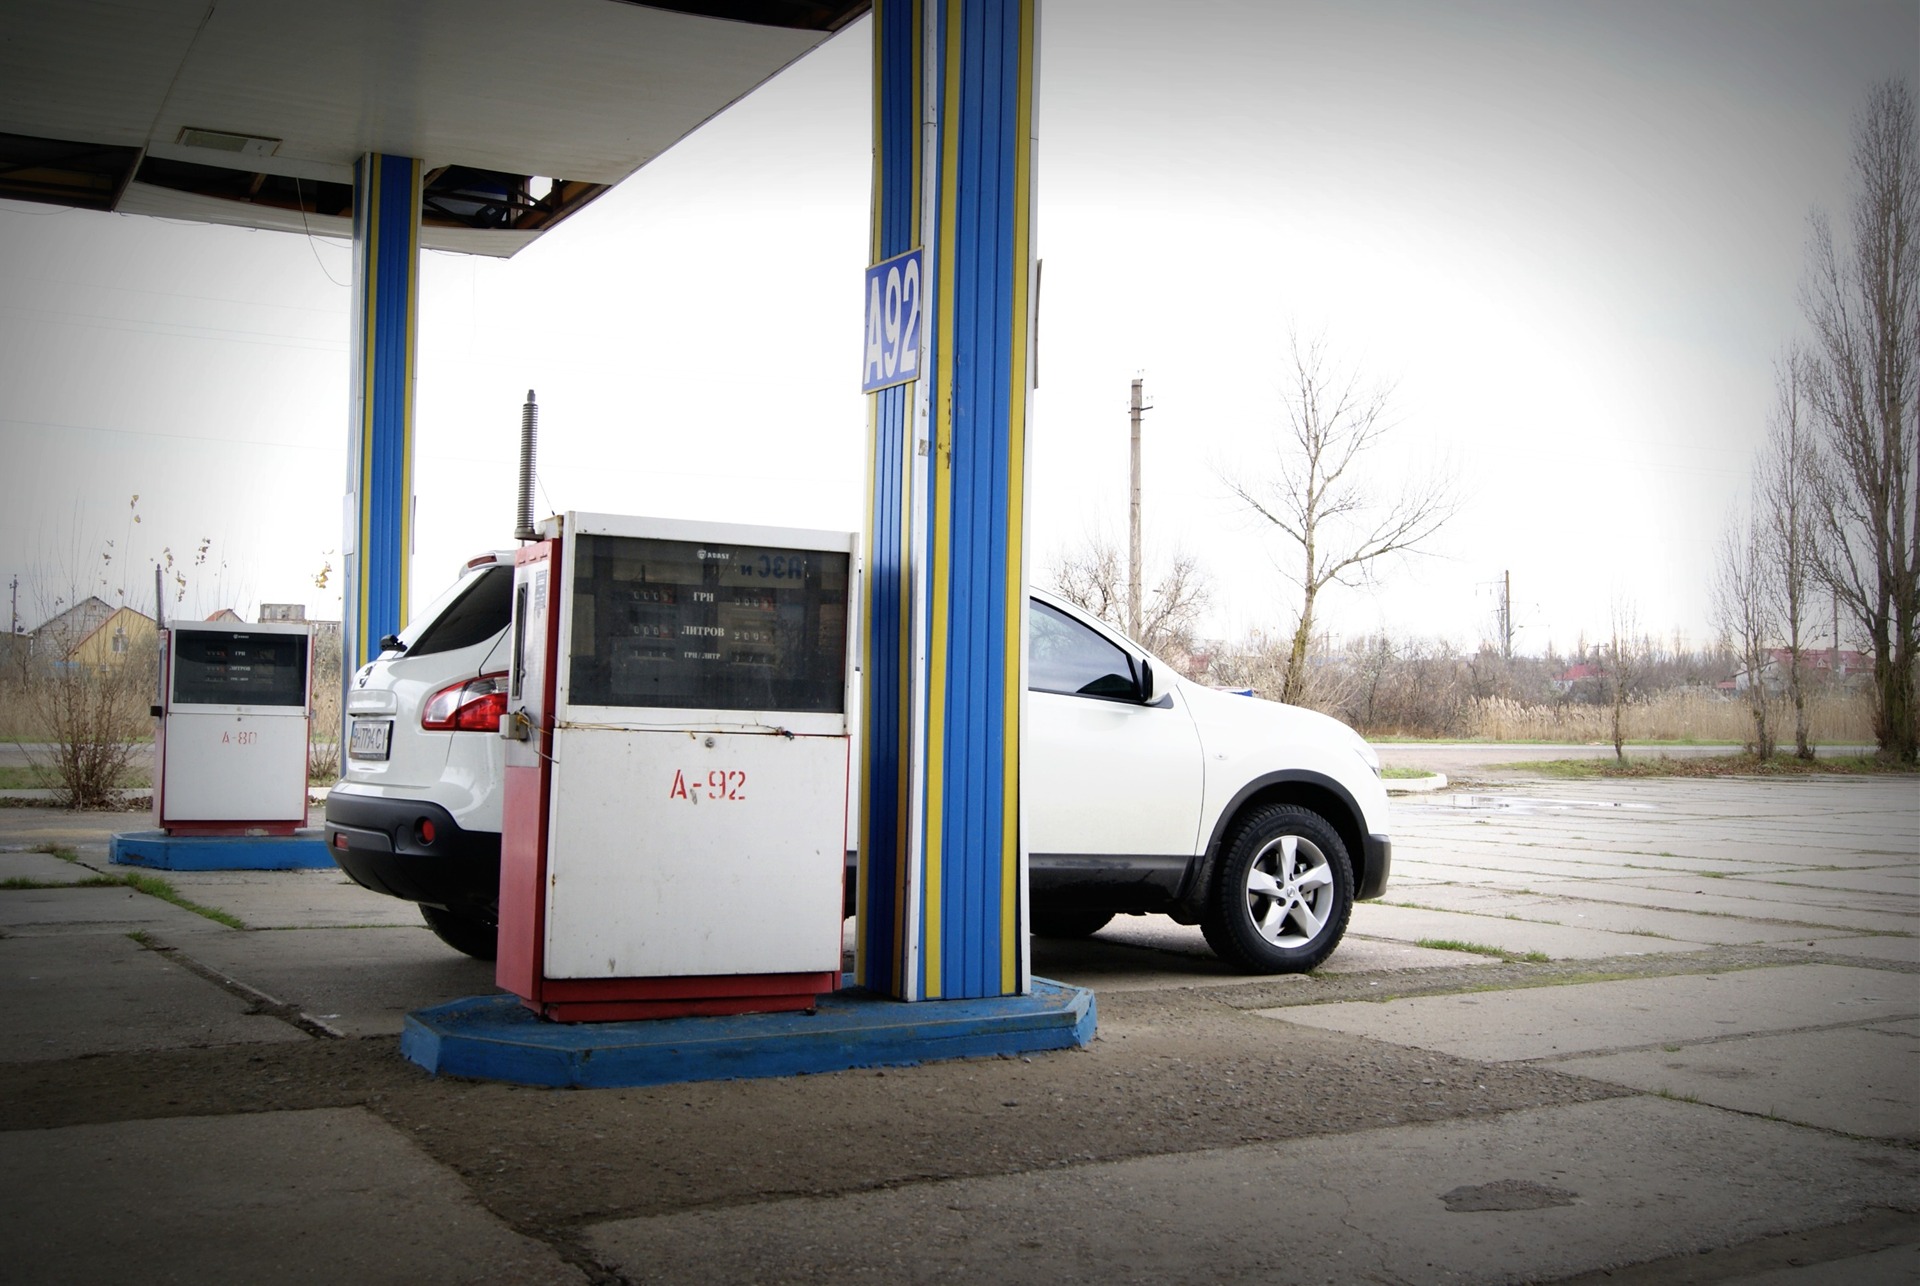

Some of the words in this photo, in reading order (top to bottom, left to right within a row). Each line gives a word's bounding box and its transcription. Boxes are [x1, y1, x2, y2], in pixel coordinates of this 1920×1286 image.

[864, 258, 919, 384] A92
[693, 592, 714, 602] ГРН
[681, 625, 725, 637] ЛИТРОВ
[222, 731, 257, 745] A-80
[670, 769, 746, 800] A-92
